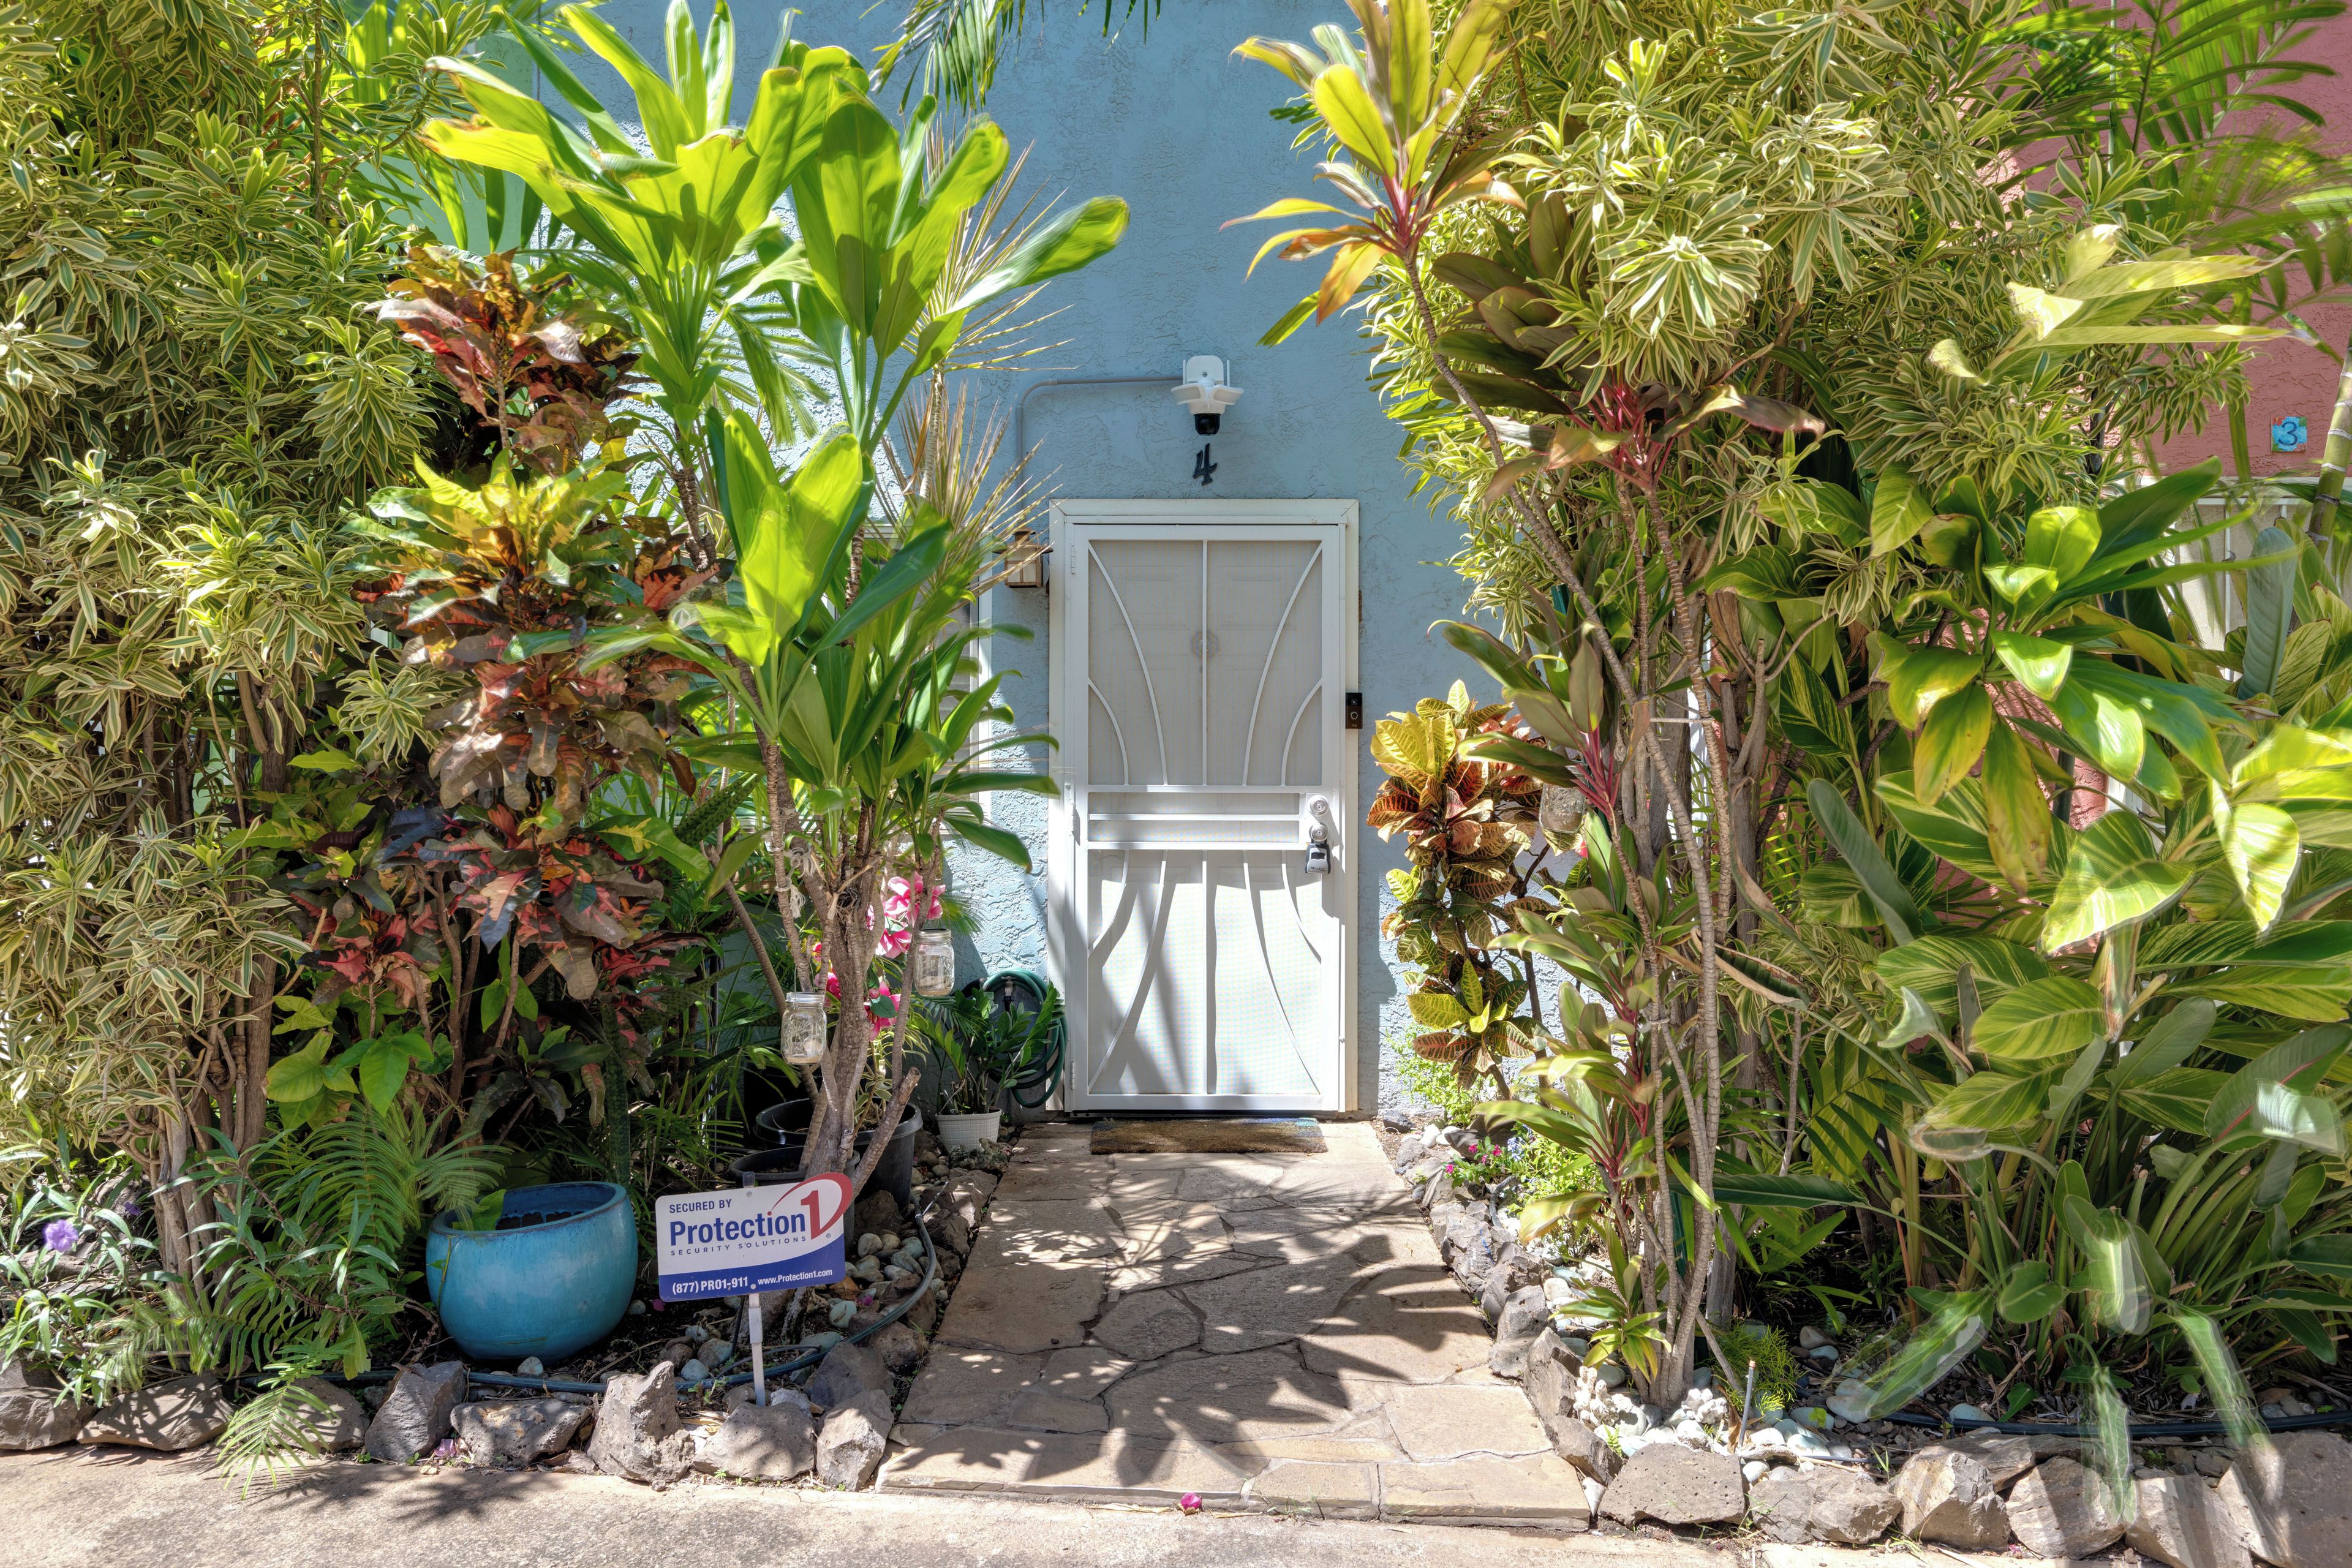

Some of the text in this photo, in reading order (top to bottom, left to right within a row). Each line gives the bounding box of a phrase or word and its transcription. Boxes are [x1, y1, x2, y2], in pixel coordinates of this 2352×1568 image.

[2278, 421, 2298, 446] 3
[1193, 443, 1218, 486] 4
[669, 1199, 733, 1213] SECURED BY
[670, 1212, 806, 1246] Protection
[671, 1236, 807, 1256] SECURITY SOLUTIONS
[758, 1268, 832, 1285] www.Protection1.com
[672, 1281, 698, 1295] (877)
